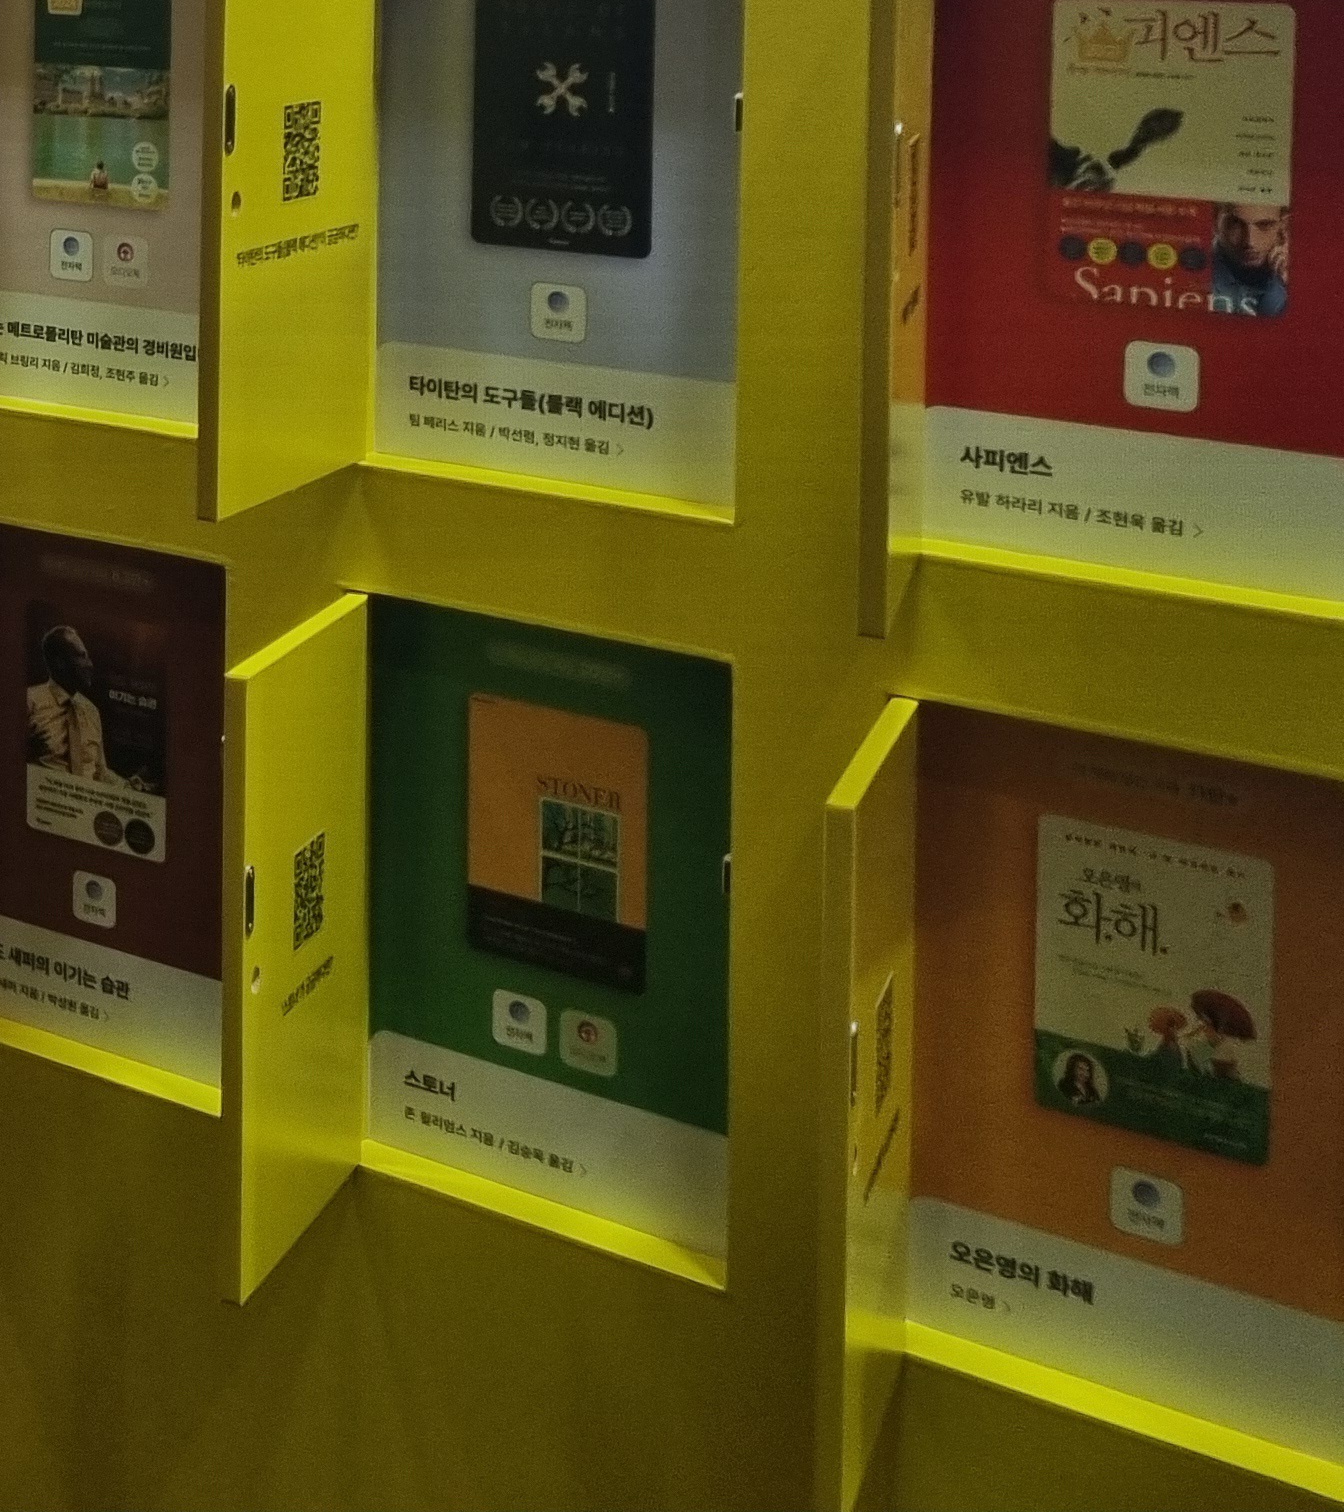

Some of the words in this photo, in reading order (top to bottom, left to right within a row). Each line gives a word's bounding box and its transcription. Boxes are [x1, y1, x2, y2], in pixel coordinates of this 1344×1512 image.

[1064, 5, 1281, 64] 피엔스
[7, 320, 83, 347] 메트로폴리탄
[86, 331, 139, 355] 미술관의
[41, 357, 61, 374] 지음
[409, 374, 478, 404] 타이탄의
[588, 400, 654, 431] 에디션)
[462, 420, 487, 438] 지음
[542, 431, 580, 452] 정지현
[959, 445, 1053, 478] 사피엔스
[959, 488, 990, 509] 유발
[994, 494, 1043, 516] 하라리
[1047, 500, 1080, 522] 지음
[1096, 507, 1145, 532] 조현욱
[53, 959, 98, 989] 이기는
[101, 976, 130, 1001] 습관
[403, 1068, 457, 1103] 스토너
[470, 1127, 495, 1148] 지음
[949, 1239, 1040, 1289] 오은영의
[1046, 1268, 1097, 1306] 화해
